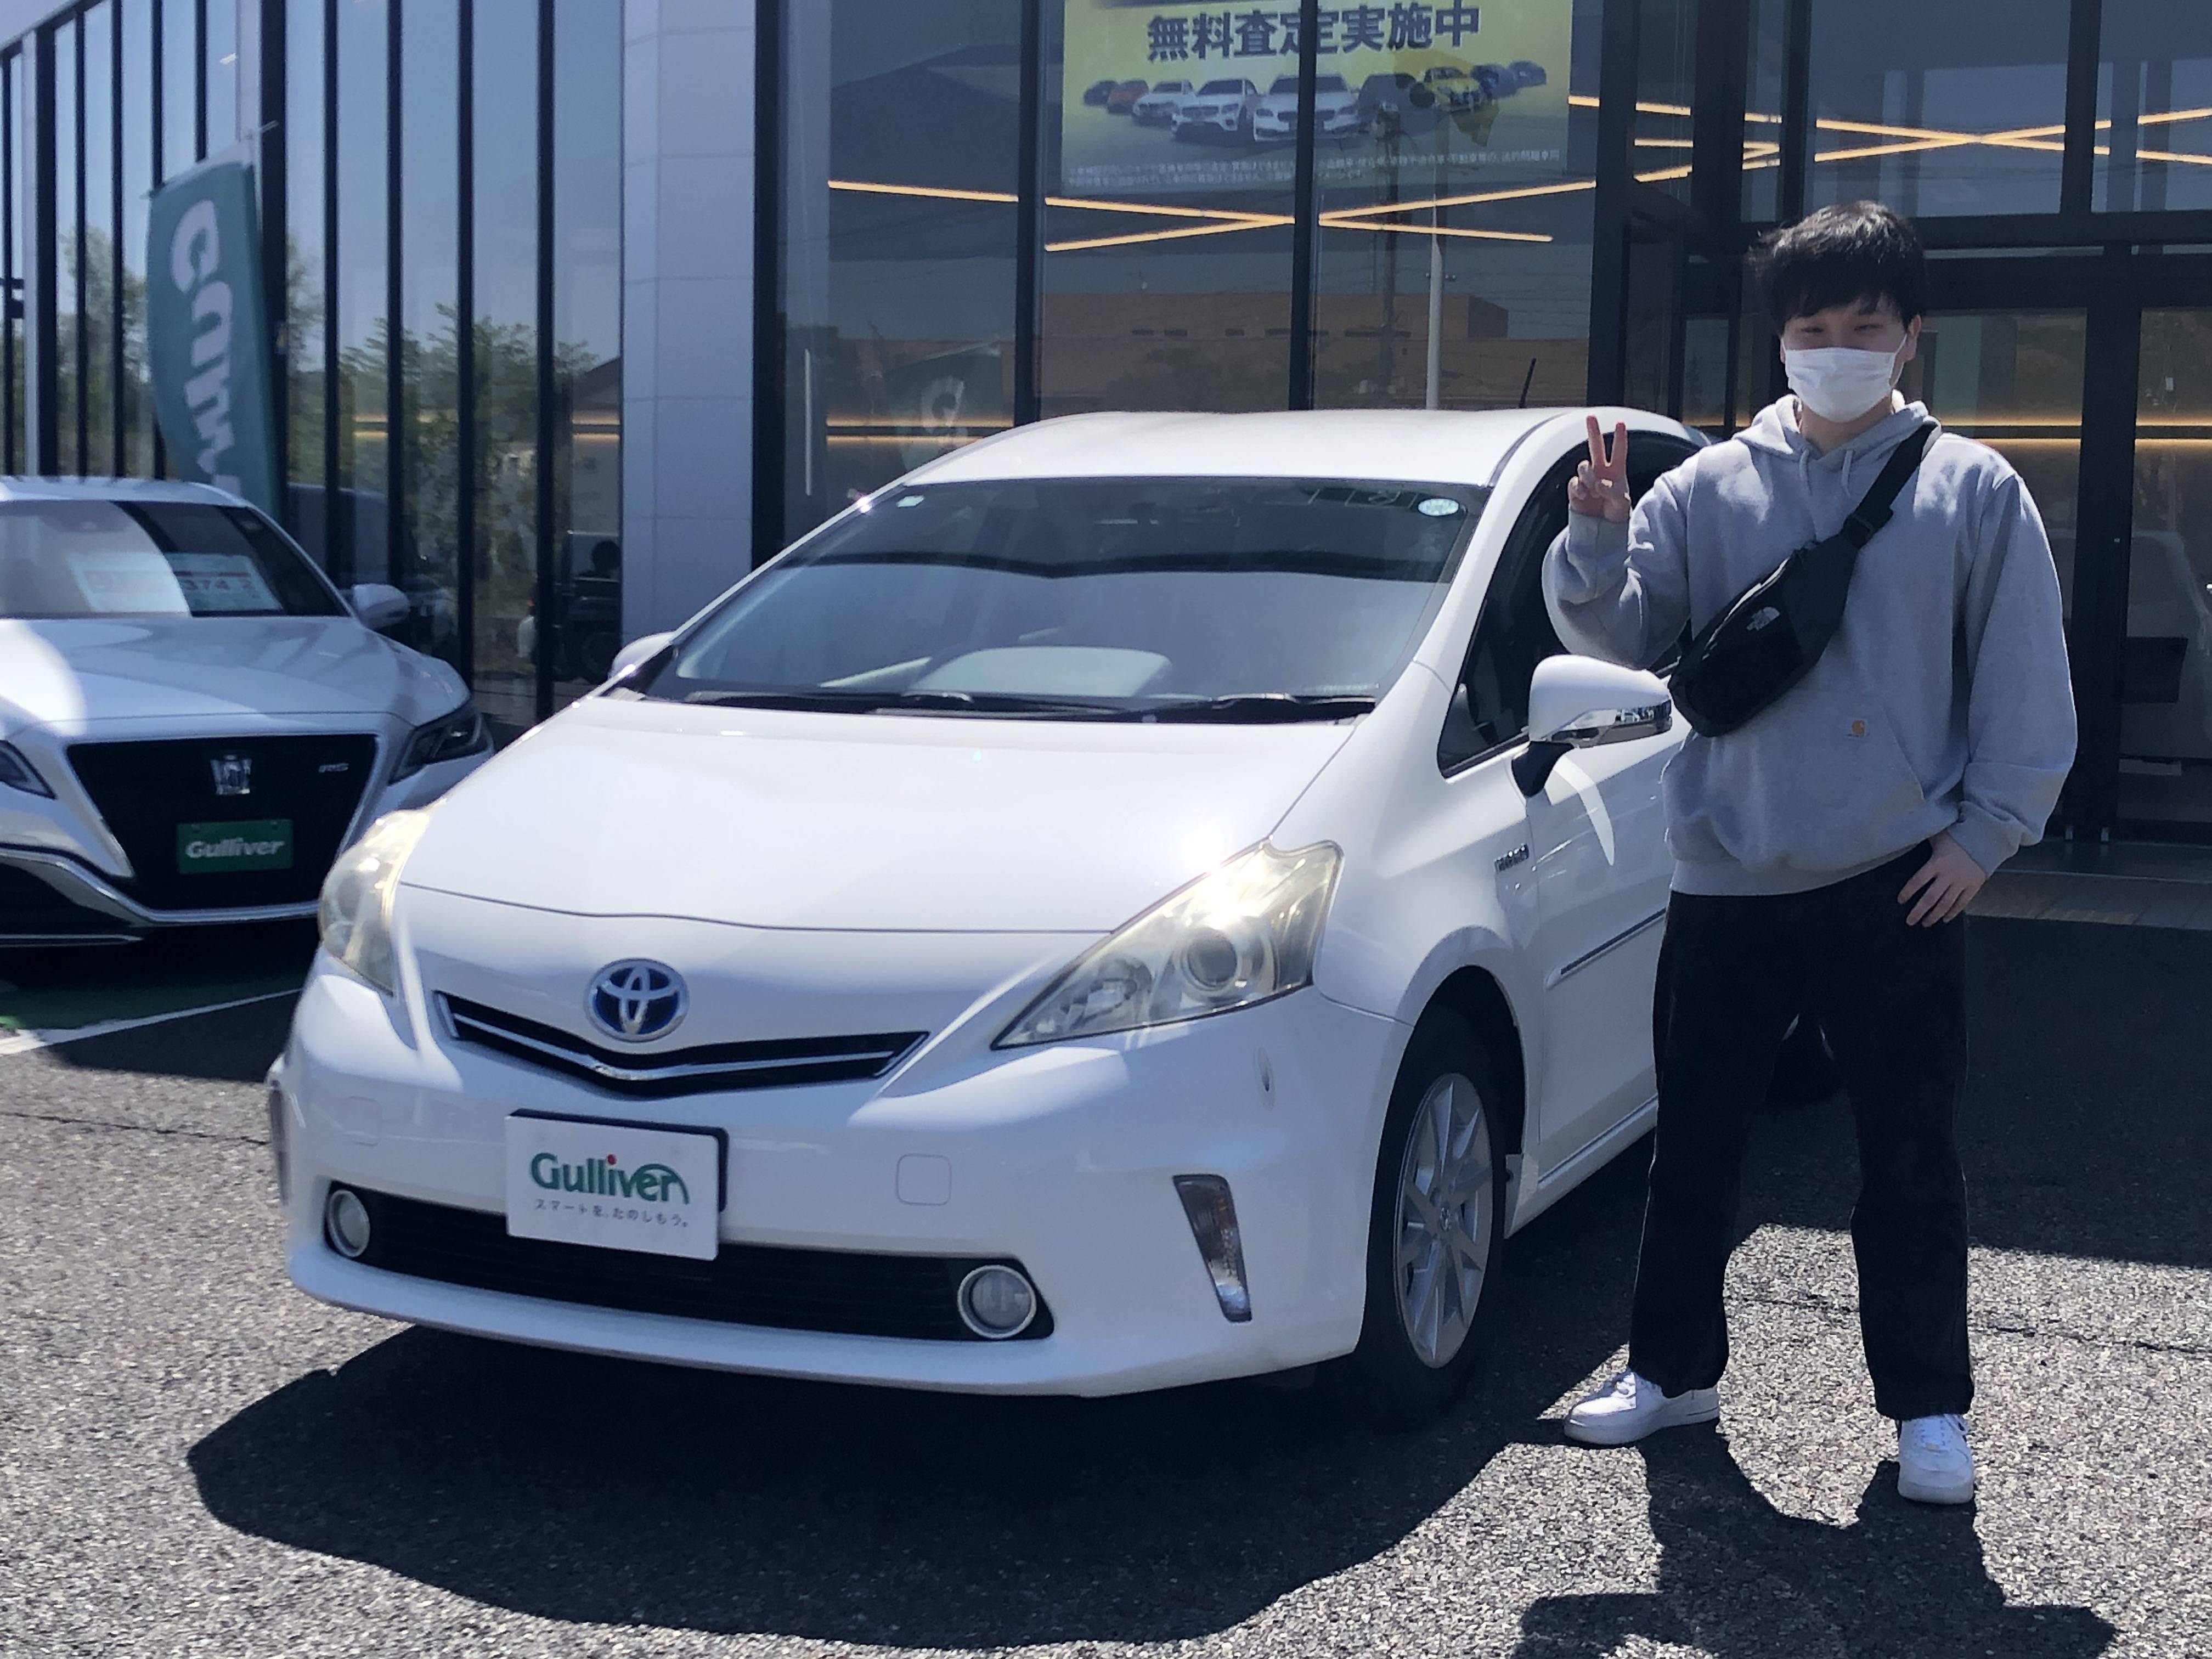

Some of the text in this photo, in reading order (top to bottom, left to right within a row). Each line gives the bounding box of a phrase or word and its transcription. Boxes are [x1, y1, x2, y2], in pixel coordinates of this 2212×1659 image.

[1147, 0, 1480, 63] 無料査定実施中
[185, 837, 285, 859] Gulliver
[531, 1152, 690, 1204] Gulliver
